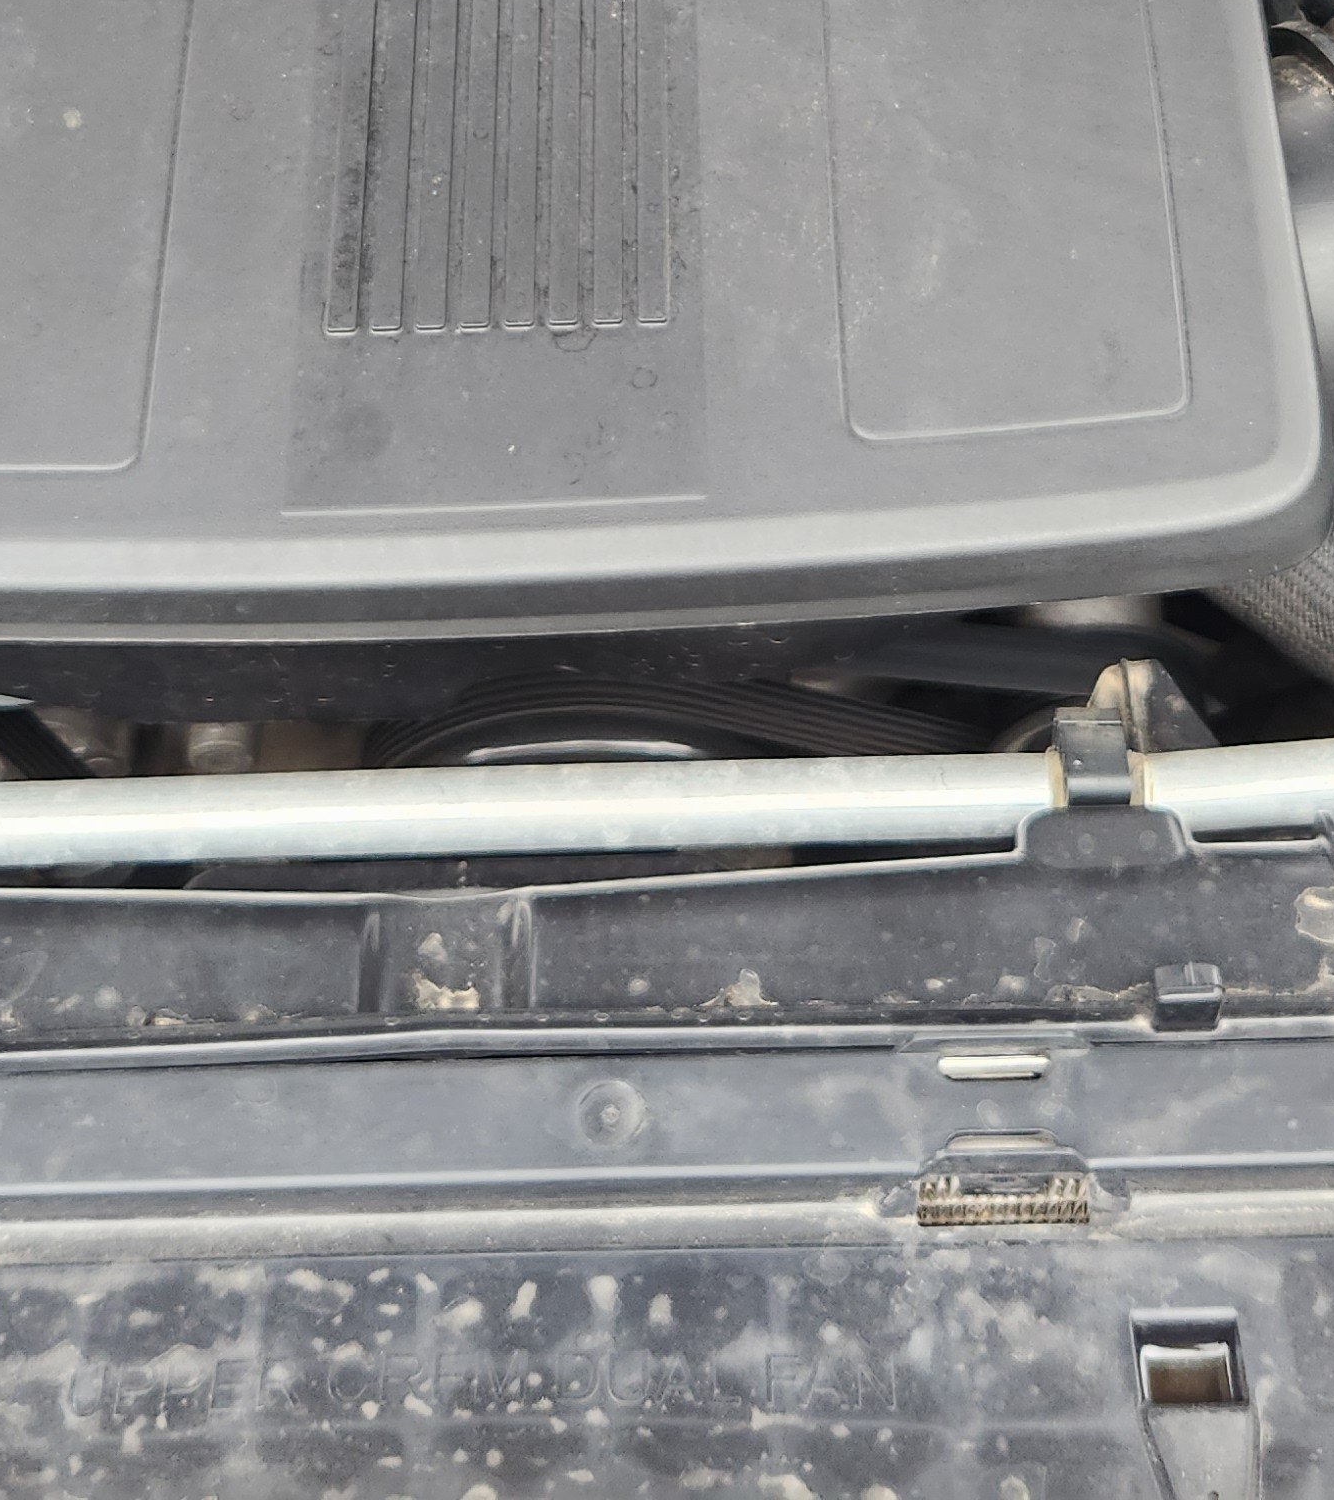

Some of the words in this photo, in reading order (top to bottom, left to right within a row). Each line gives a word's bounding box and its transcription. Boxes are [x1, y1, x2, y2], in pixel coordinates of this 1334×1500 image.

[69, 1356, 301, 1420] UPPER
[555, 1350, 742, 1406] DUAL
[764, 1351, 898, 1411] FAN
